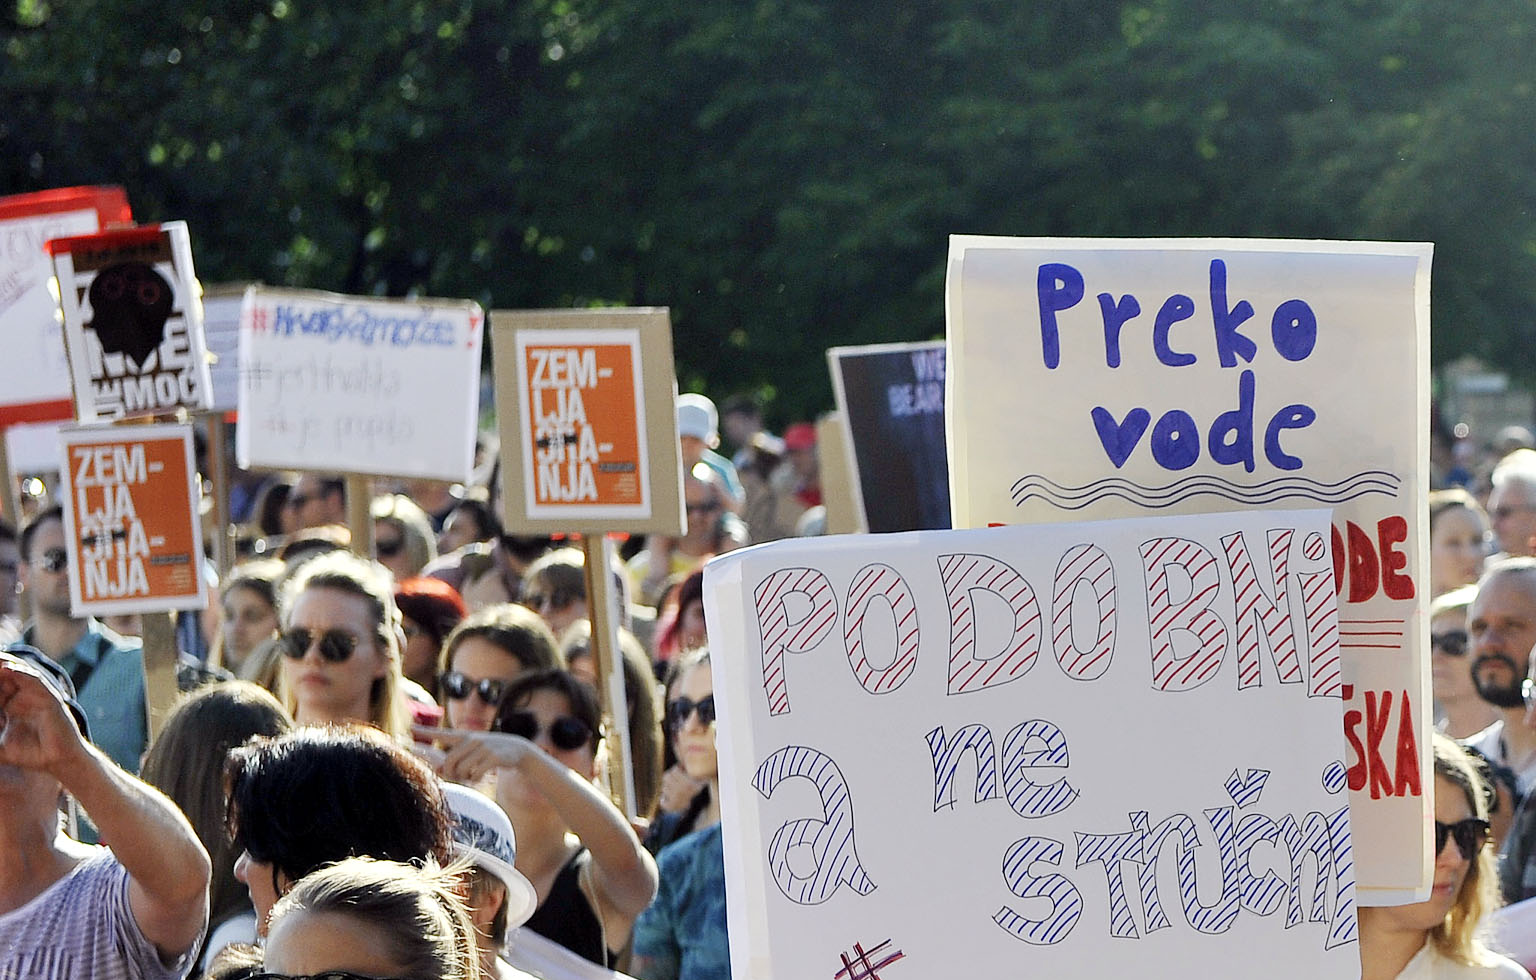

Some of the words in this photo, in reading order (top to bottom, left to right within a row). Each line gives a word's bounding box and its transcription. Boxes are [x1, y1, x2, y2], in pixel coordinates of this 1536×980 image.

[1036, 258, 1318, 370] Preko
[530, 349, 614, 389] ZEM-
[74, 443, 164, 487] ZEM-
[1089, 369, 1317, 473] vode
[925, 719, 1080, 818] ne
